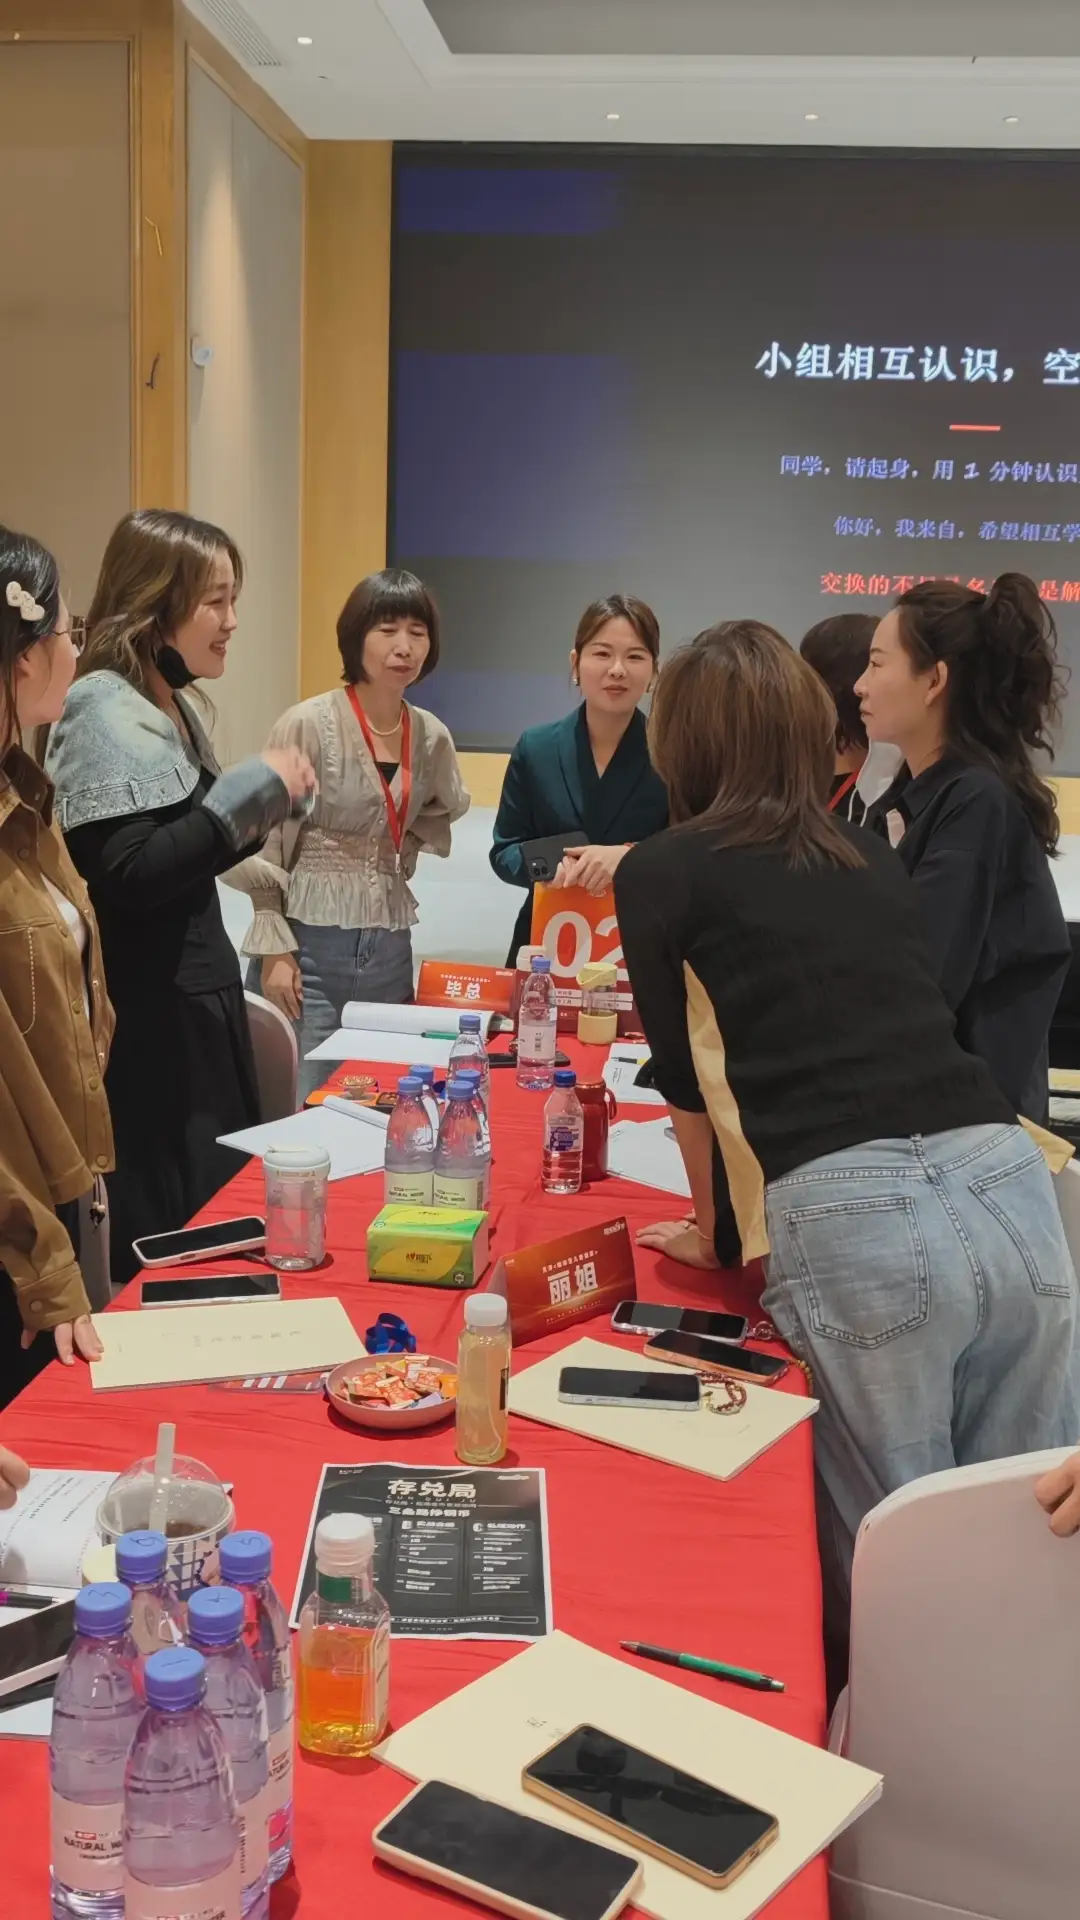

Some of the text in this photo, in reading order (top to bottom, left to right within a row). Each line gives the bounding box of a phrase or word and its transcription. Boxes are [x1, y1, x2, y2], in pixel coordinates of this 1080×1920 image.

[755, 341, 1080, 385] 小组相互认识，空
[963, 463, 979, 478] 1
[989, 460, 1080, 483] 分钟认识
[444, 980, 481, 1000] 毕总
[547, 1261, 598, 1305] 丽姐
[387, 1479, 476, 1499] 存兑局
[64, 1836, 106, 1851] NATURAL
